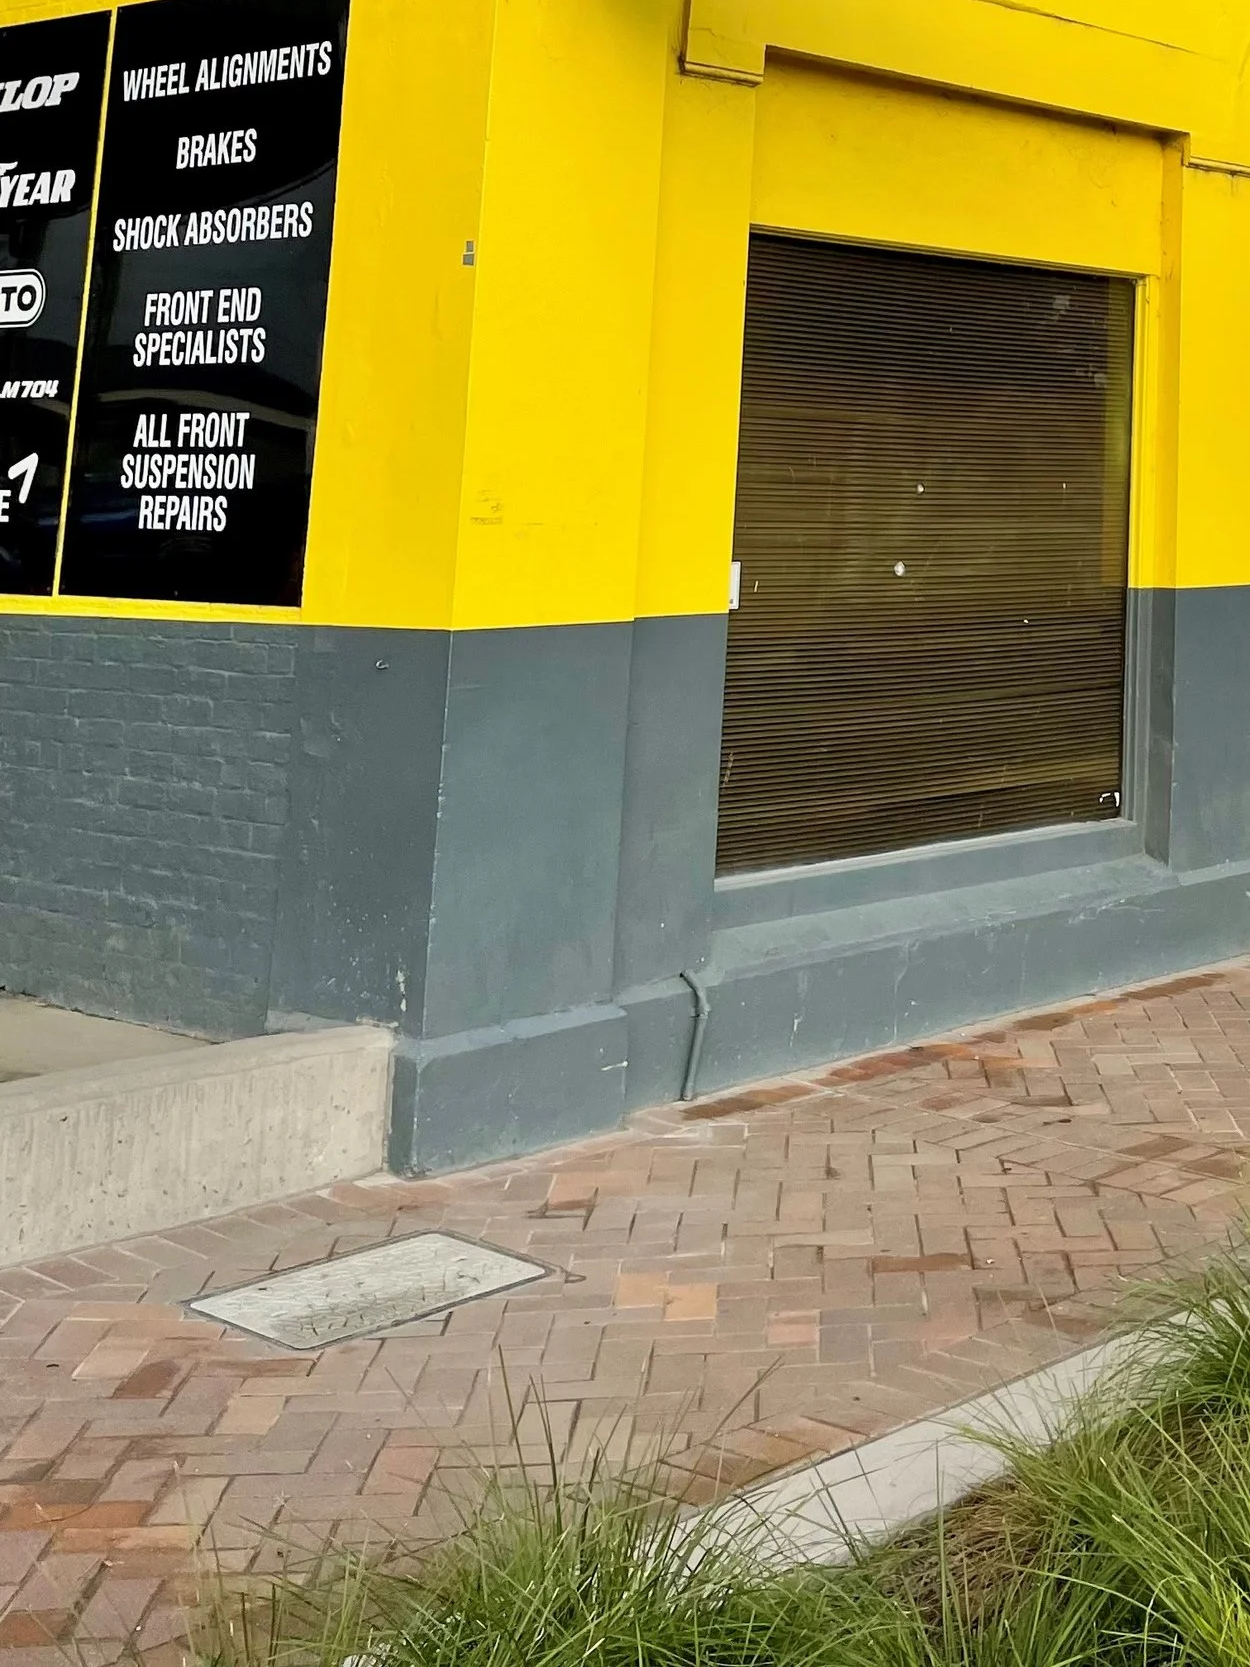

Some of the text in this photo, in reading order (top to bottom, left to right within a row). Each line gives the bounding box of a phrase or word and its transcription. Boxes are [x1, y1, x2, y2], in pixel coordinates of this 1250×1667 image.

[123, 40, 333, 102] WHEEL ALIGNMENTS
[0, 72, 80, 113] LOP
[176, 128, 257, 170] BRAKES
[113, 201, 313, 252] SHOCK ABSORBERS
[144, 287, 262, 327] FRONT END
[132, 327, 266, 368] SPECIALISTS
[132, 412, 251, 448] ALL FRONT
[121, 453, 256, 490] SUSPENSION
[138, 494, 228, 532] REPAIRS
